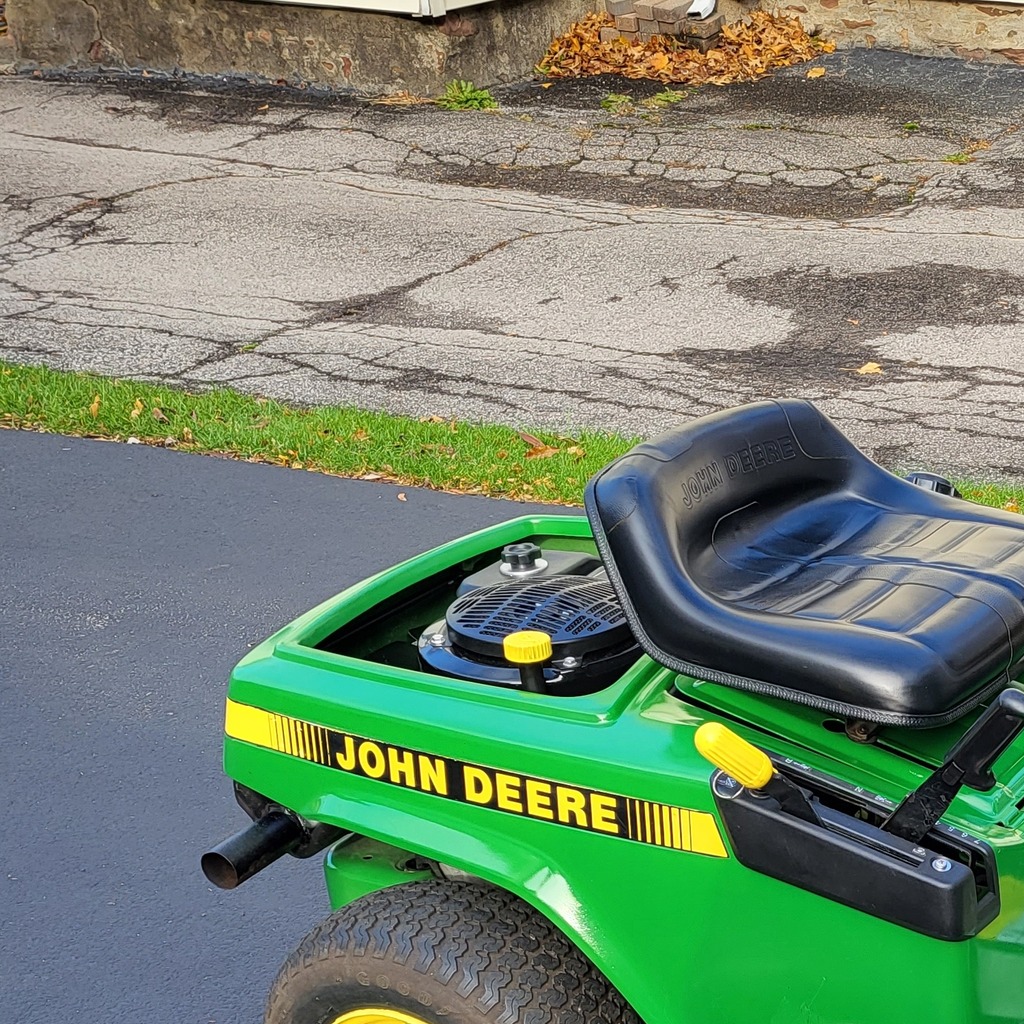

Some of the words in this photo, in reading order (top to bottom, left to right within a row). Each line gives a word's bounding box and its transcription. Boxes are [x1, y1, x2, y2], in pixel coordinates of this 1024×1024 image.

[680, 461, 723, 509] JOHN
[724, 435, 796, 479] DEERE
[336, 736, 447, 796] JOHN
[464, 765, 618, 833] DEERE
